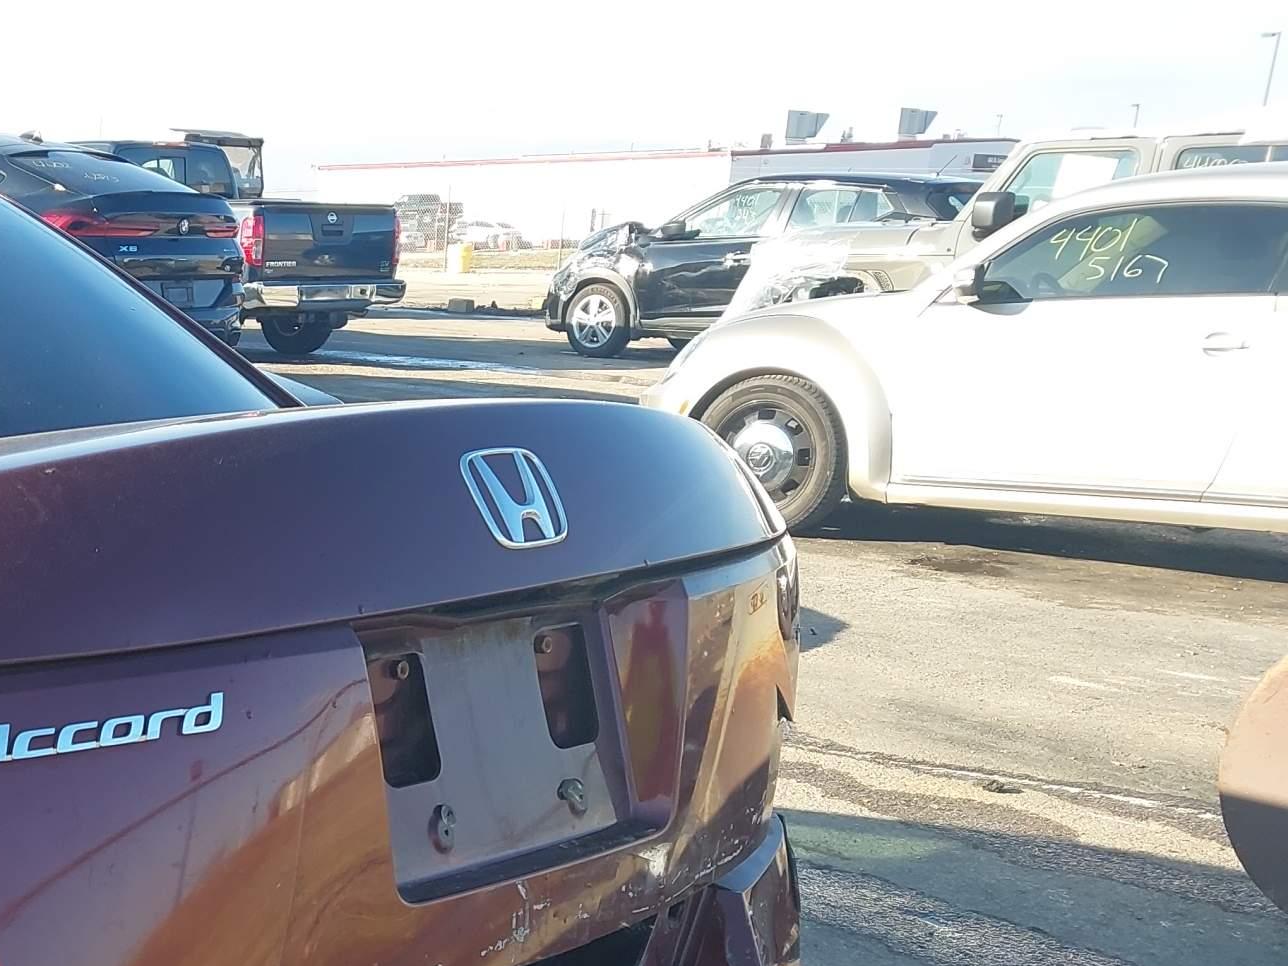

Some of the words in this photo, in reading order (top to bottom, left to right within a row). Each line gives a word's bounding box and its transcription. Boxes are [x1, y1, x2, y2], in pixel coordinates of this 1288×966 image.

[118, 244, 138, 252] X6
[1050, 217, 1138, 260] 4401
[265, 260, 297, 268] FRONTIER
[1086, 254, 1169, 284] 5167
